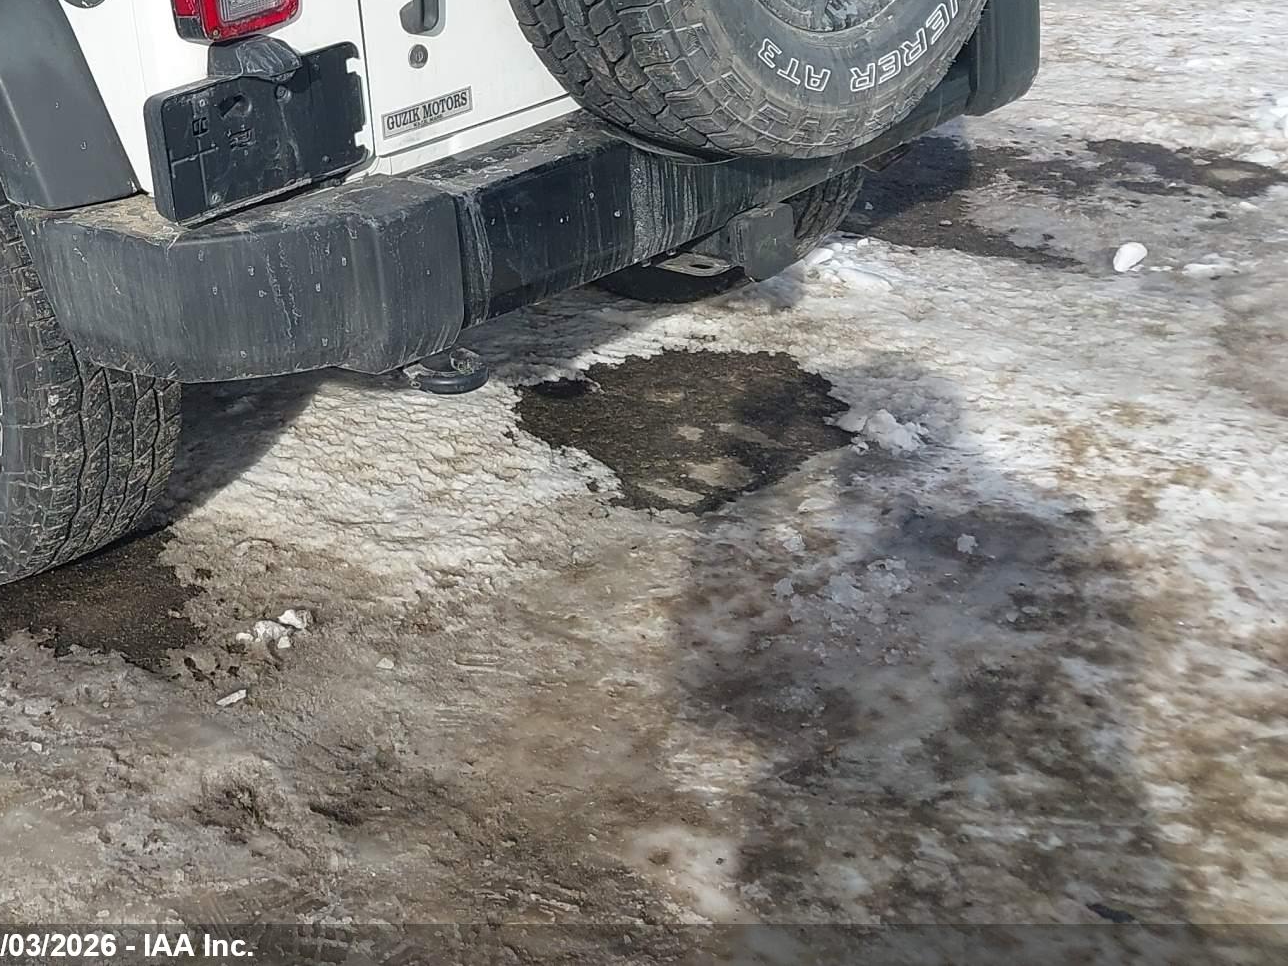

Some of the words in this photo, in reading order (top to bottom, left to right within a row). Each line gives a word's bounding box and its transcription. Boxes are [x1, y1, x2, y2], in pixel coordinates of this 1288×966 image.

[758, 38, 831, 91] AT3
[386, 107, 420, 130] GUZIK
[422, 91, 467, 119] MOTORS
